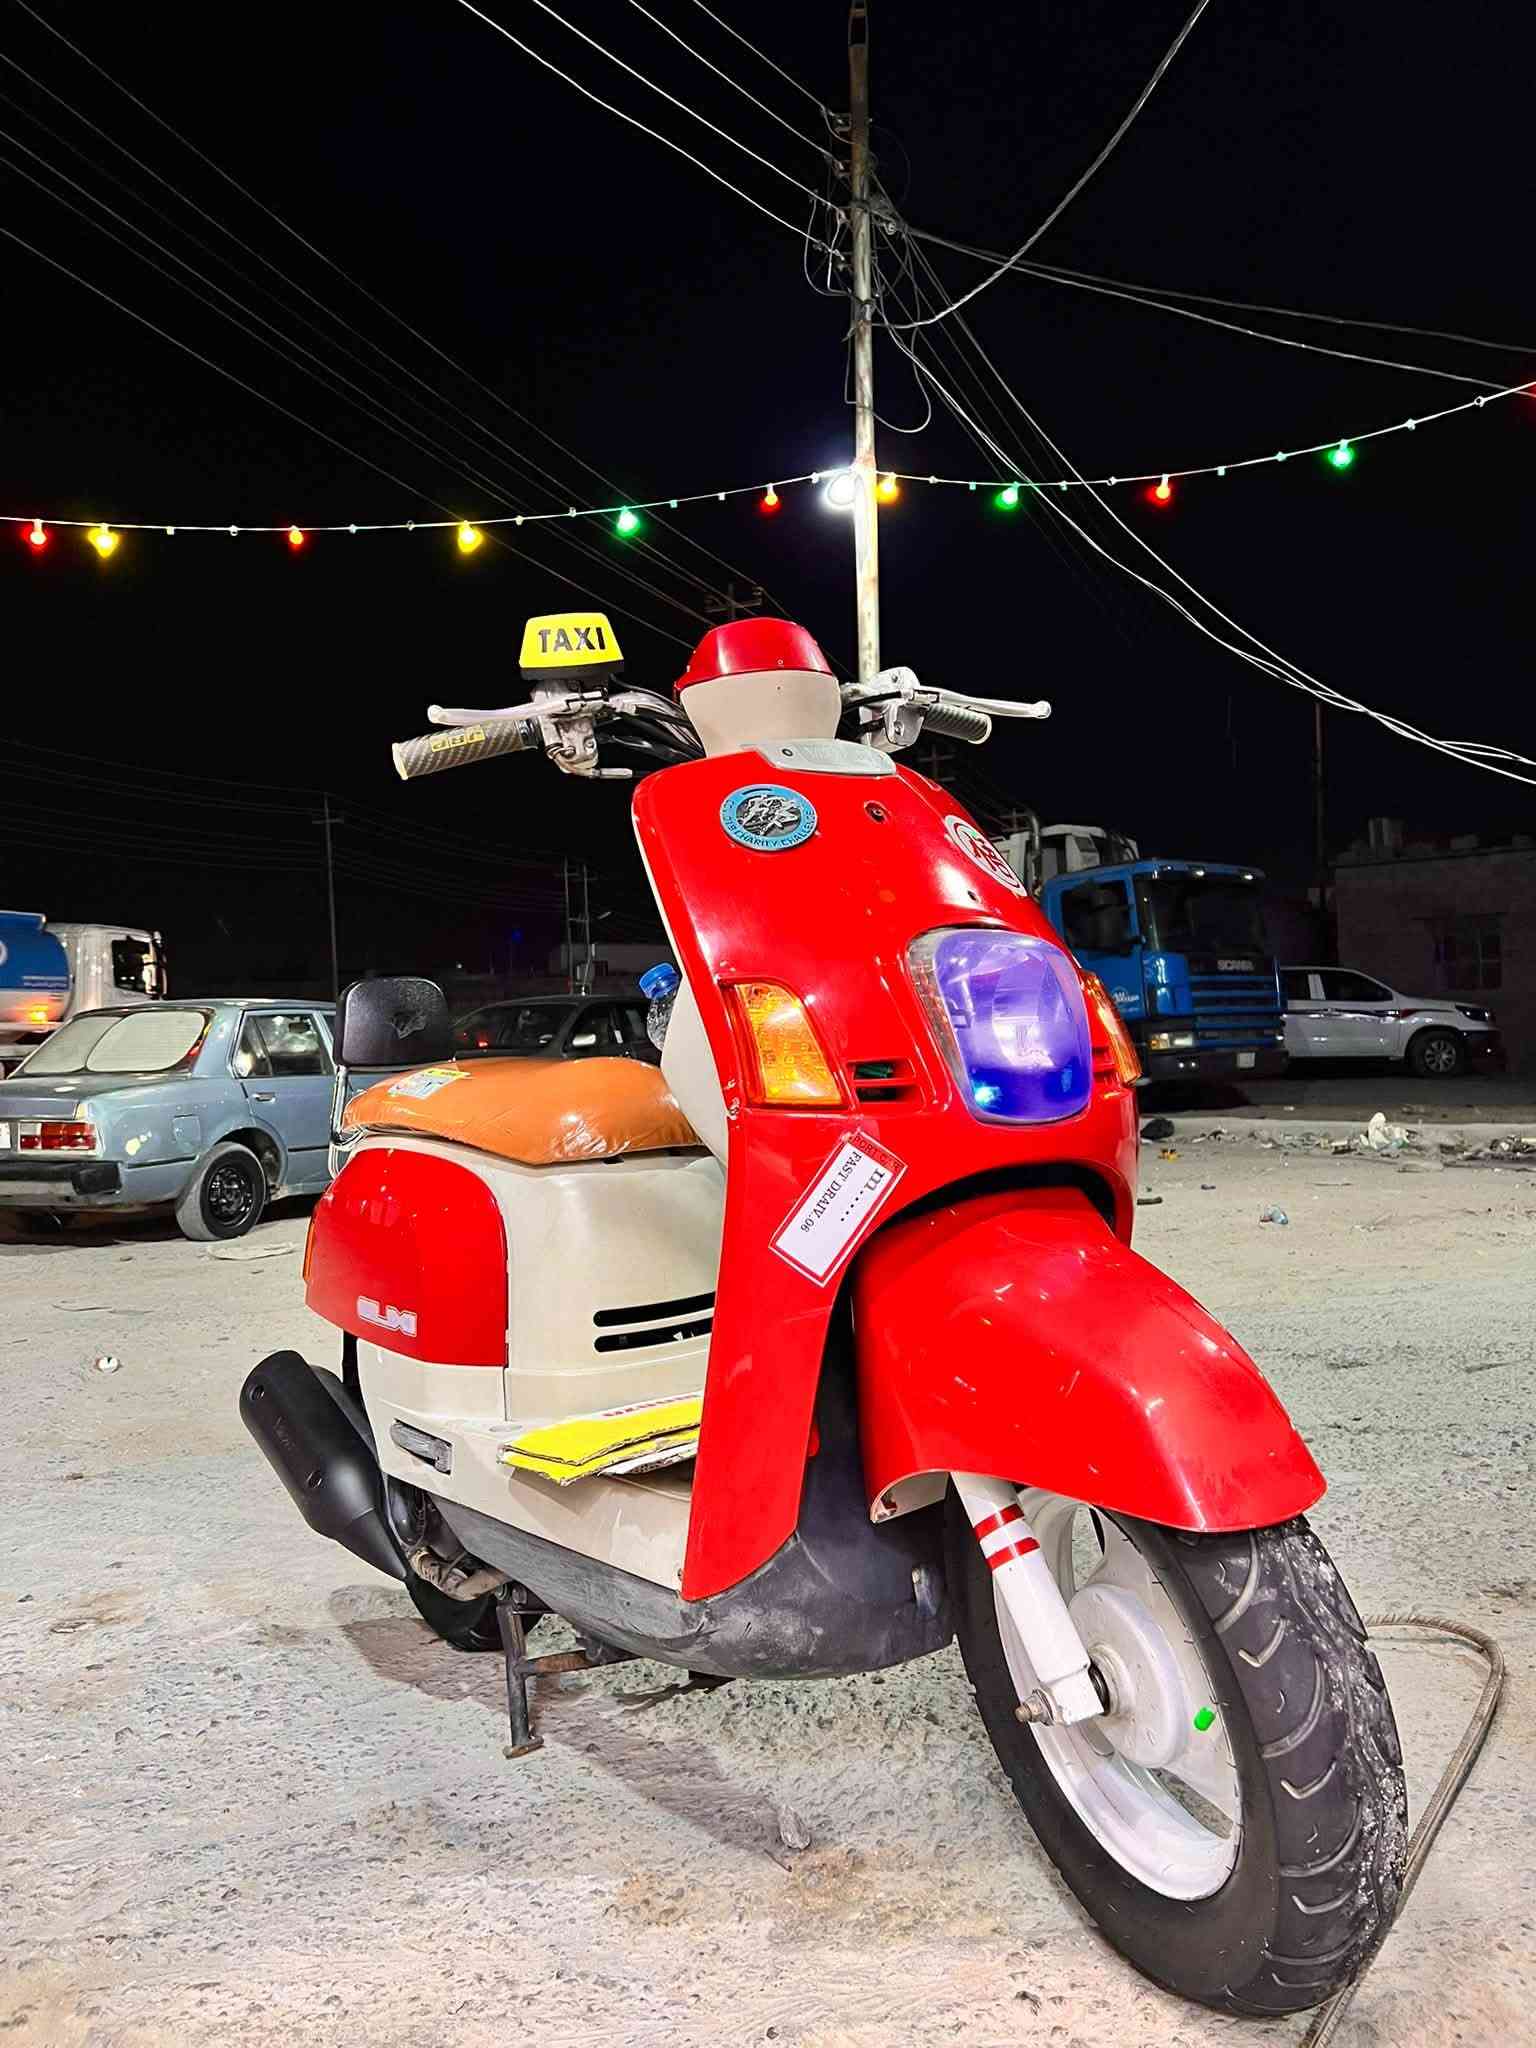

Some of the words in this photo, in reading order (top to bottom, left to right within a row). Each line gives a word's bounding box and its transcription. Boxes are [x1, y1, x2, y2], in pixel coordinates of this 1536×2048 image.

[538, 627, 606, 653] TAXI
[734, 831, 778, 847] CHARITY
[838, 1151, 862, 1180] FAST
